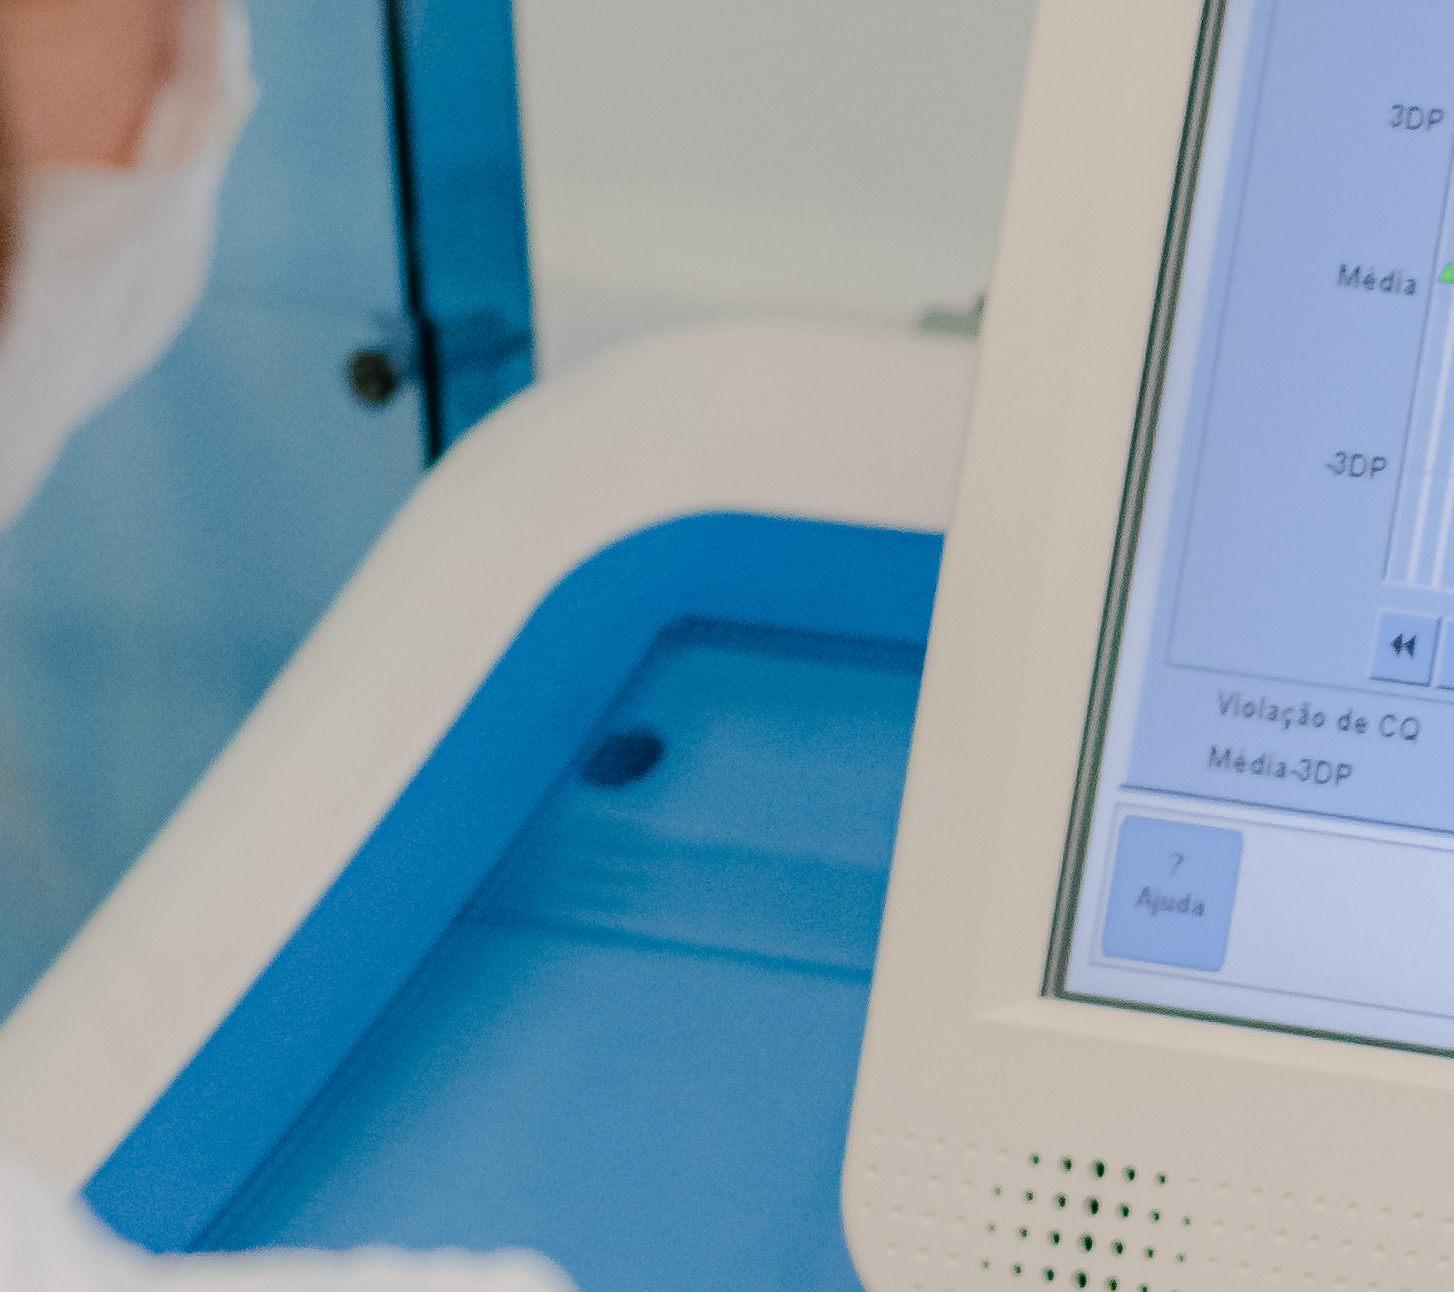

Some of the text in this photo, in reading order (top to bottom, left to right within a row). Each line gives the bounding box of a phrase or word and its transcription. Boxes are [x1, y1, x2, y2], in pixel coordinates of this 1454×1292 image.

[1389, 102, 1446, 133] 3DP
[1336, 262, 1419, 298] Média
[1324, 449, 1391, 480] -3DP
[1215, 688, 1423, 745] Violação de CQ
[1206, 743, 1354, 788] Média-3DP
[1133, 885, 1207, 918] Ajuda
